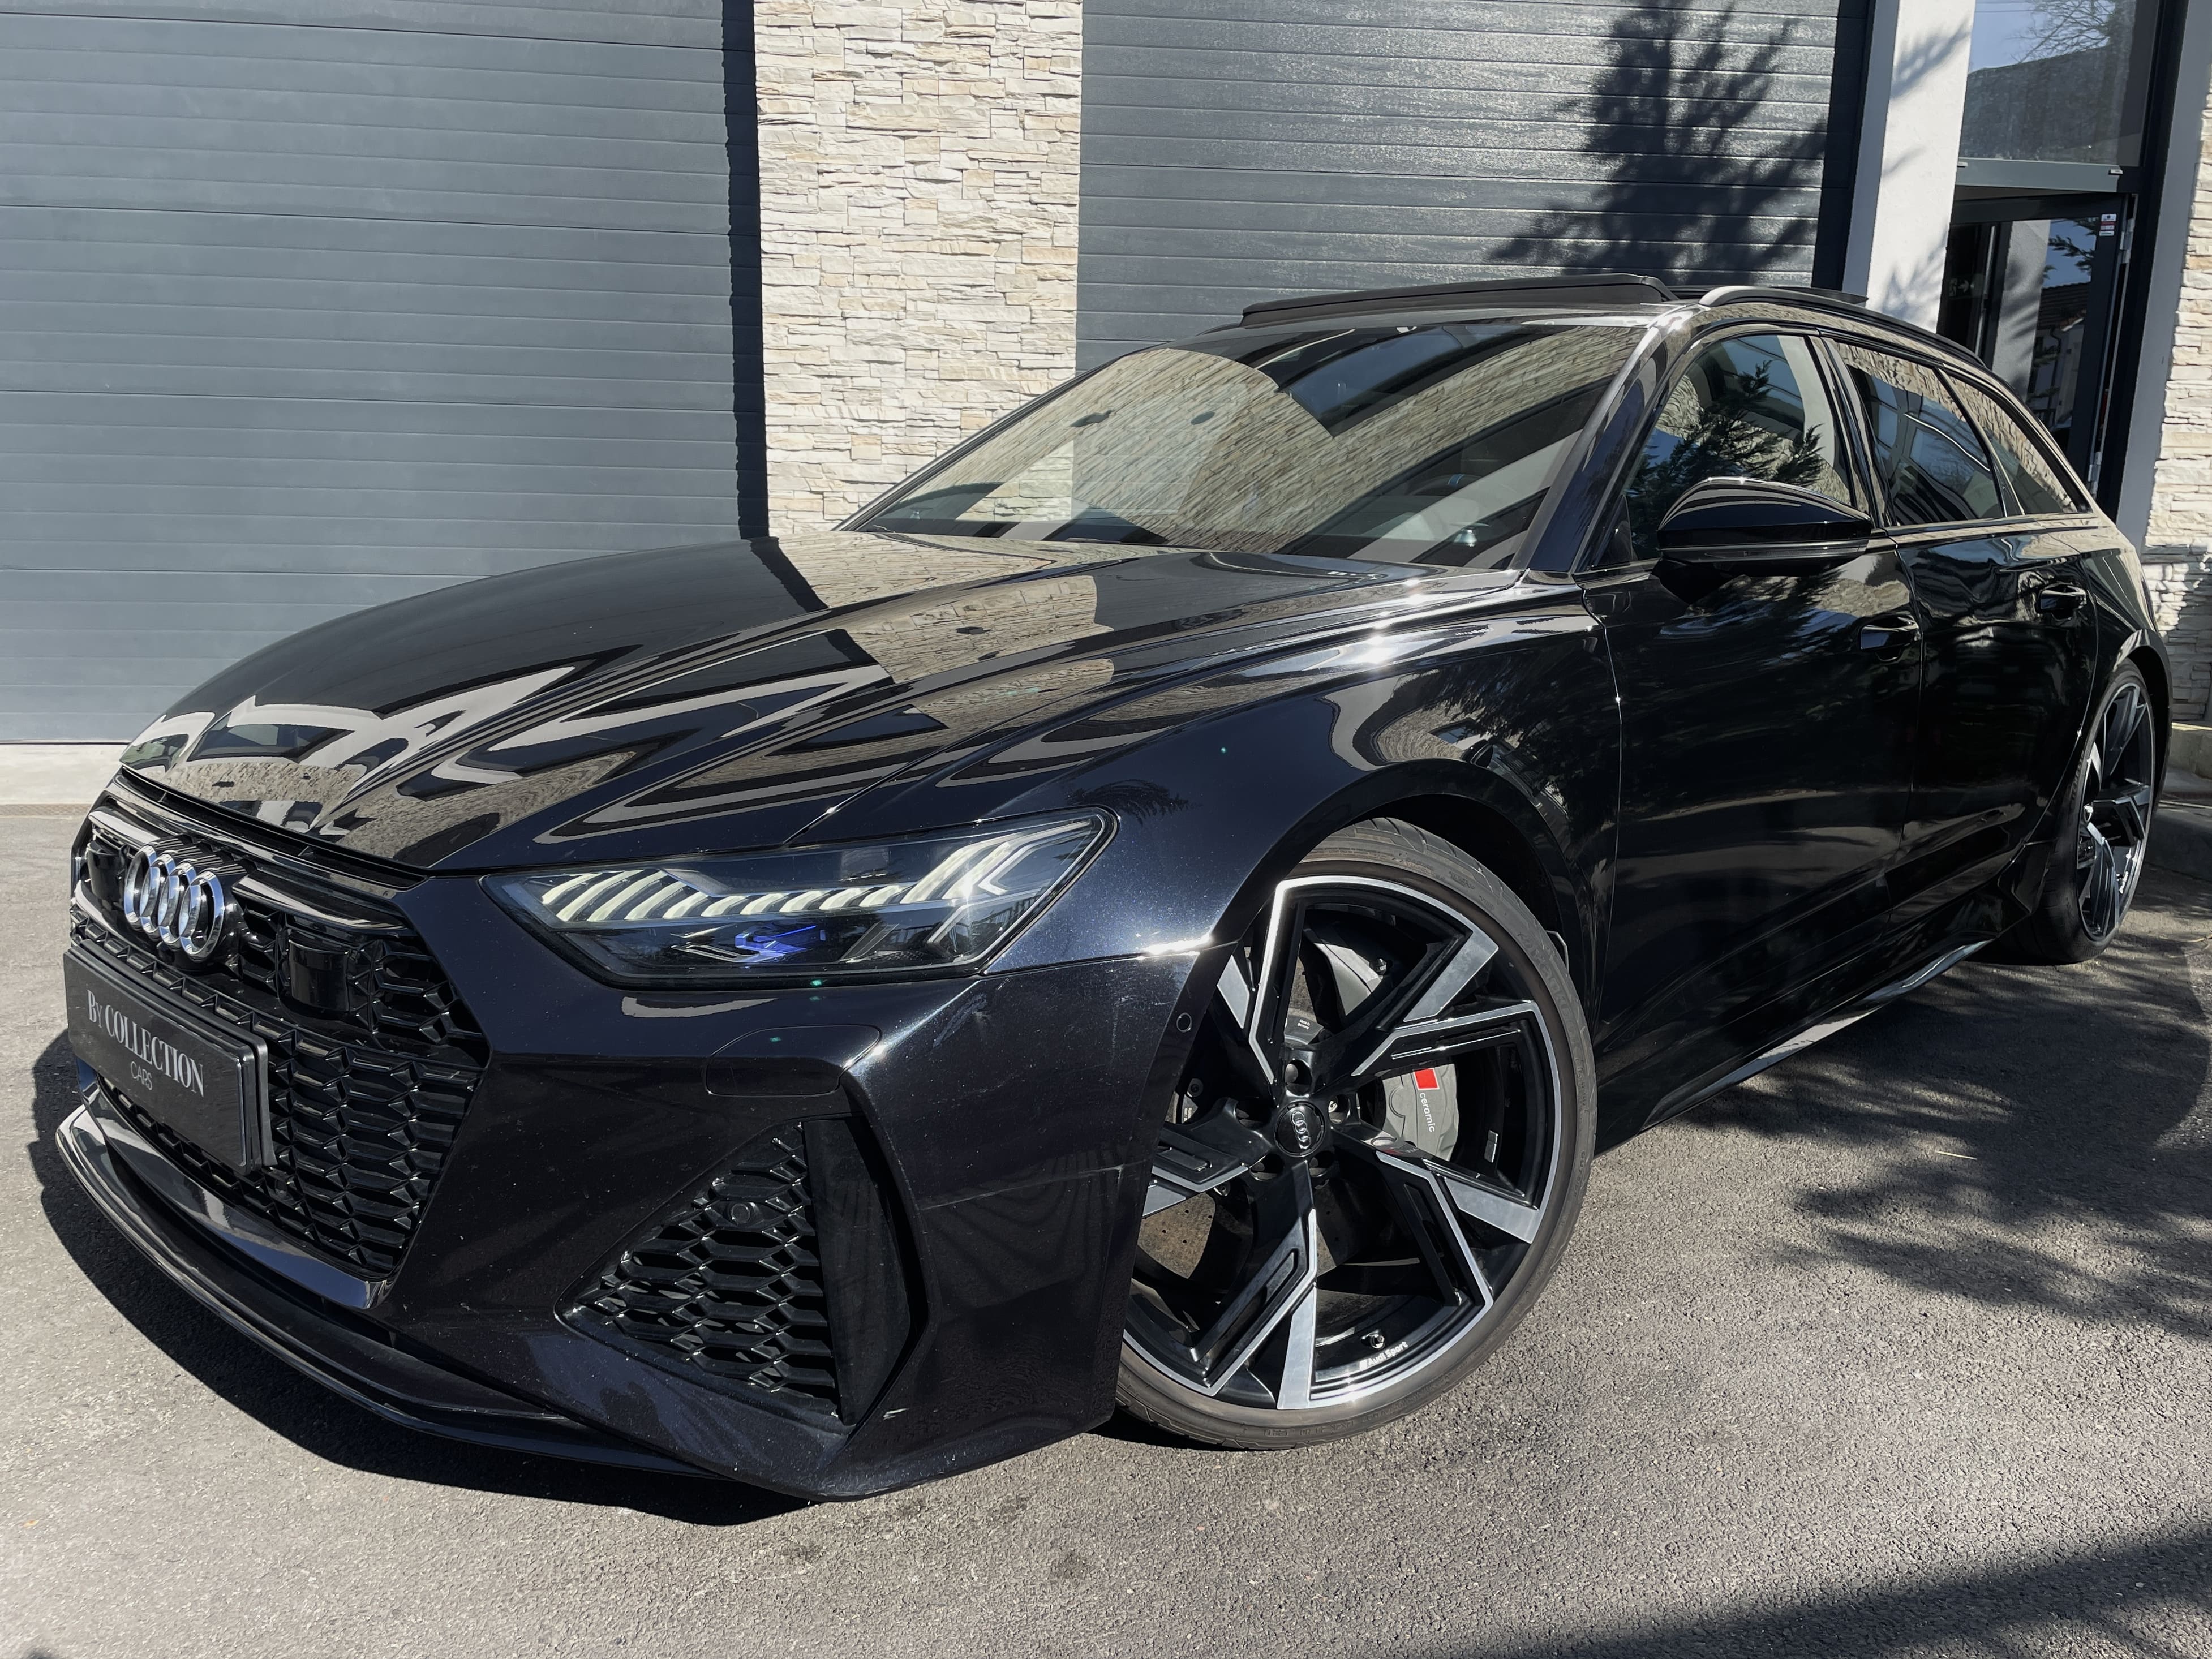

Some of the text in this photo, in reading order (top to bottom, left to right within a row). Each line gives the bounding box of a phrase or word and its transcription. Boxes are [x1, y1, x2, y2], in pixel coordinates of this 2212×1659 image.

[105, 1004, 204, 1098] COLLECTION
[130, 1061, 153, 1090] CARS
[1419, 1092, 1436, 1132] ceramic
[1368, 1341, 1408, 1366] Audi Sport
